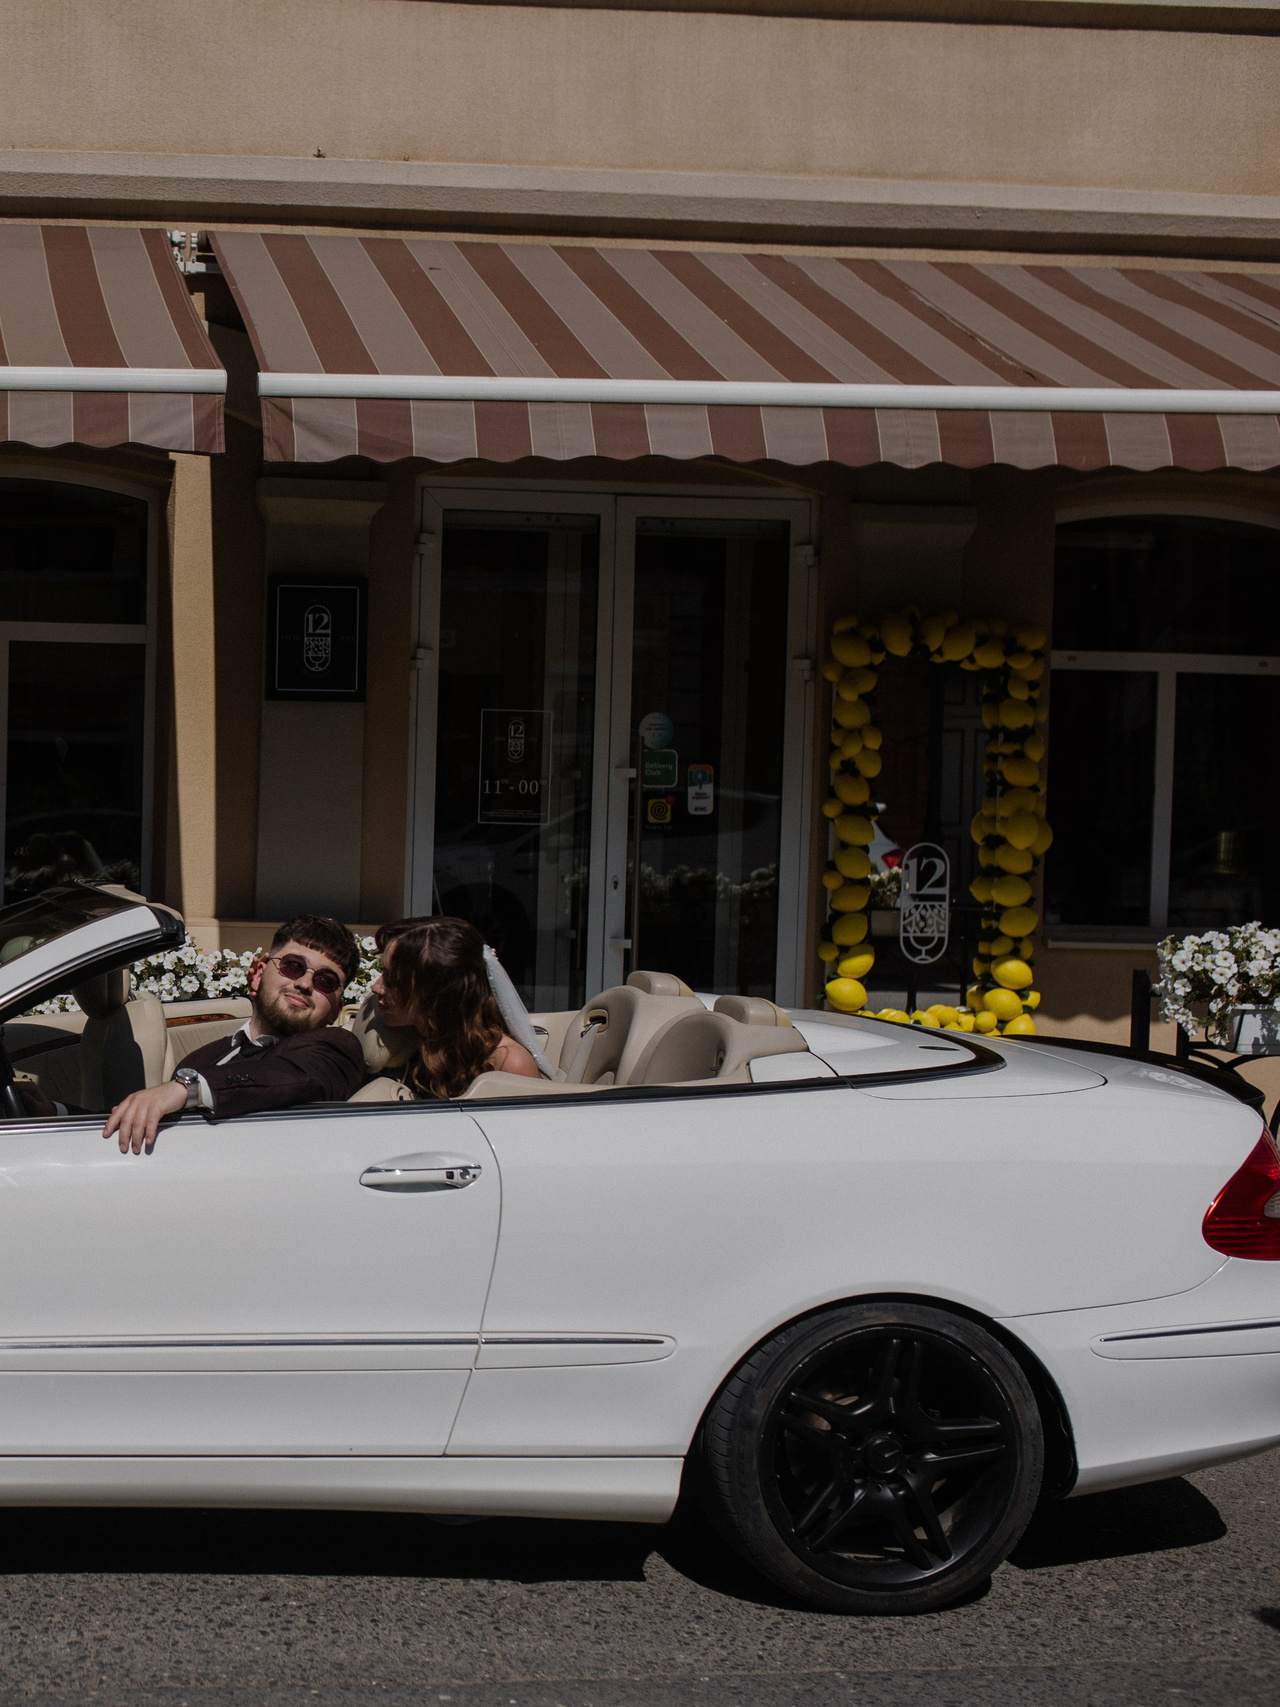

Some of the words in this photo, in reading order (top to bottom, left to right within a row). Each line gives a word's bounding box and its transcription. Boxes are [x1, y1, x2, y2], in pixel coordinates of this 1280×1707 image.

[307, 613, 330, 634] 12
[510, 724, 524, 737] 12
[905, 857, 946, 894] 12
